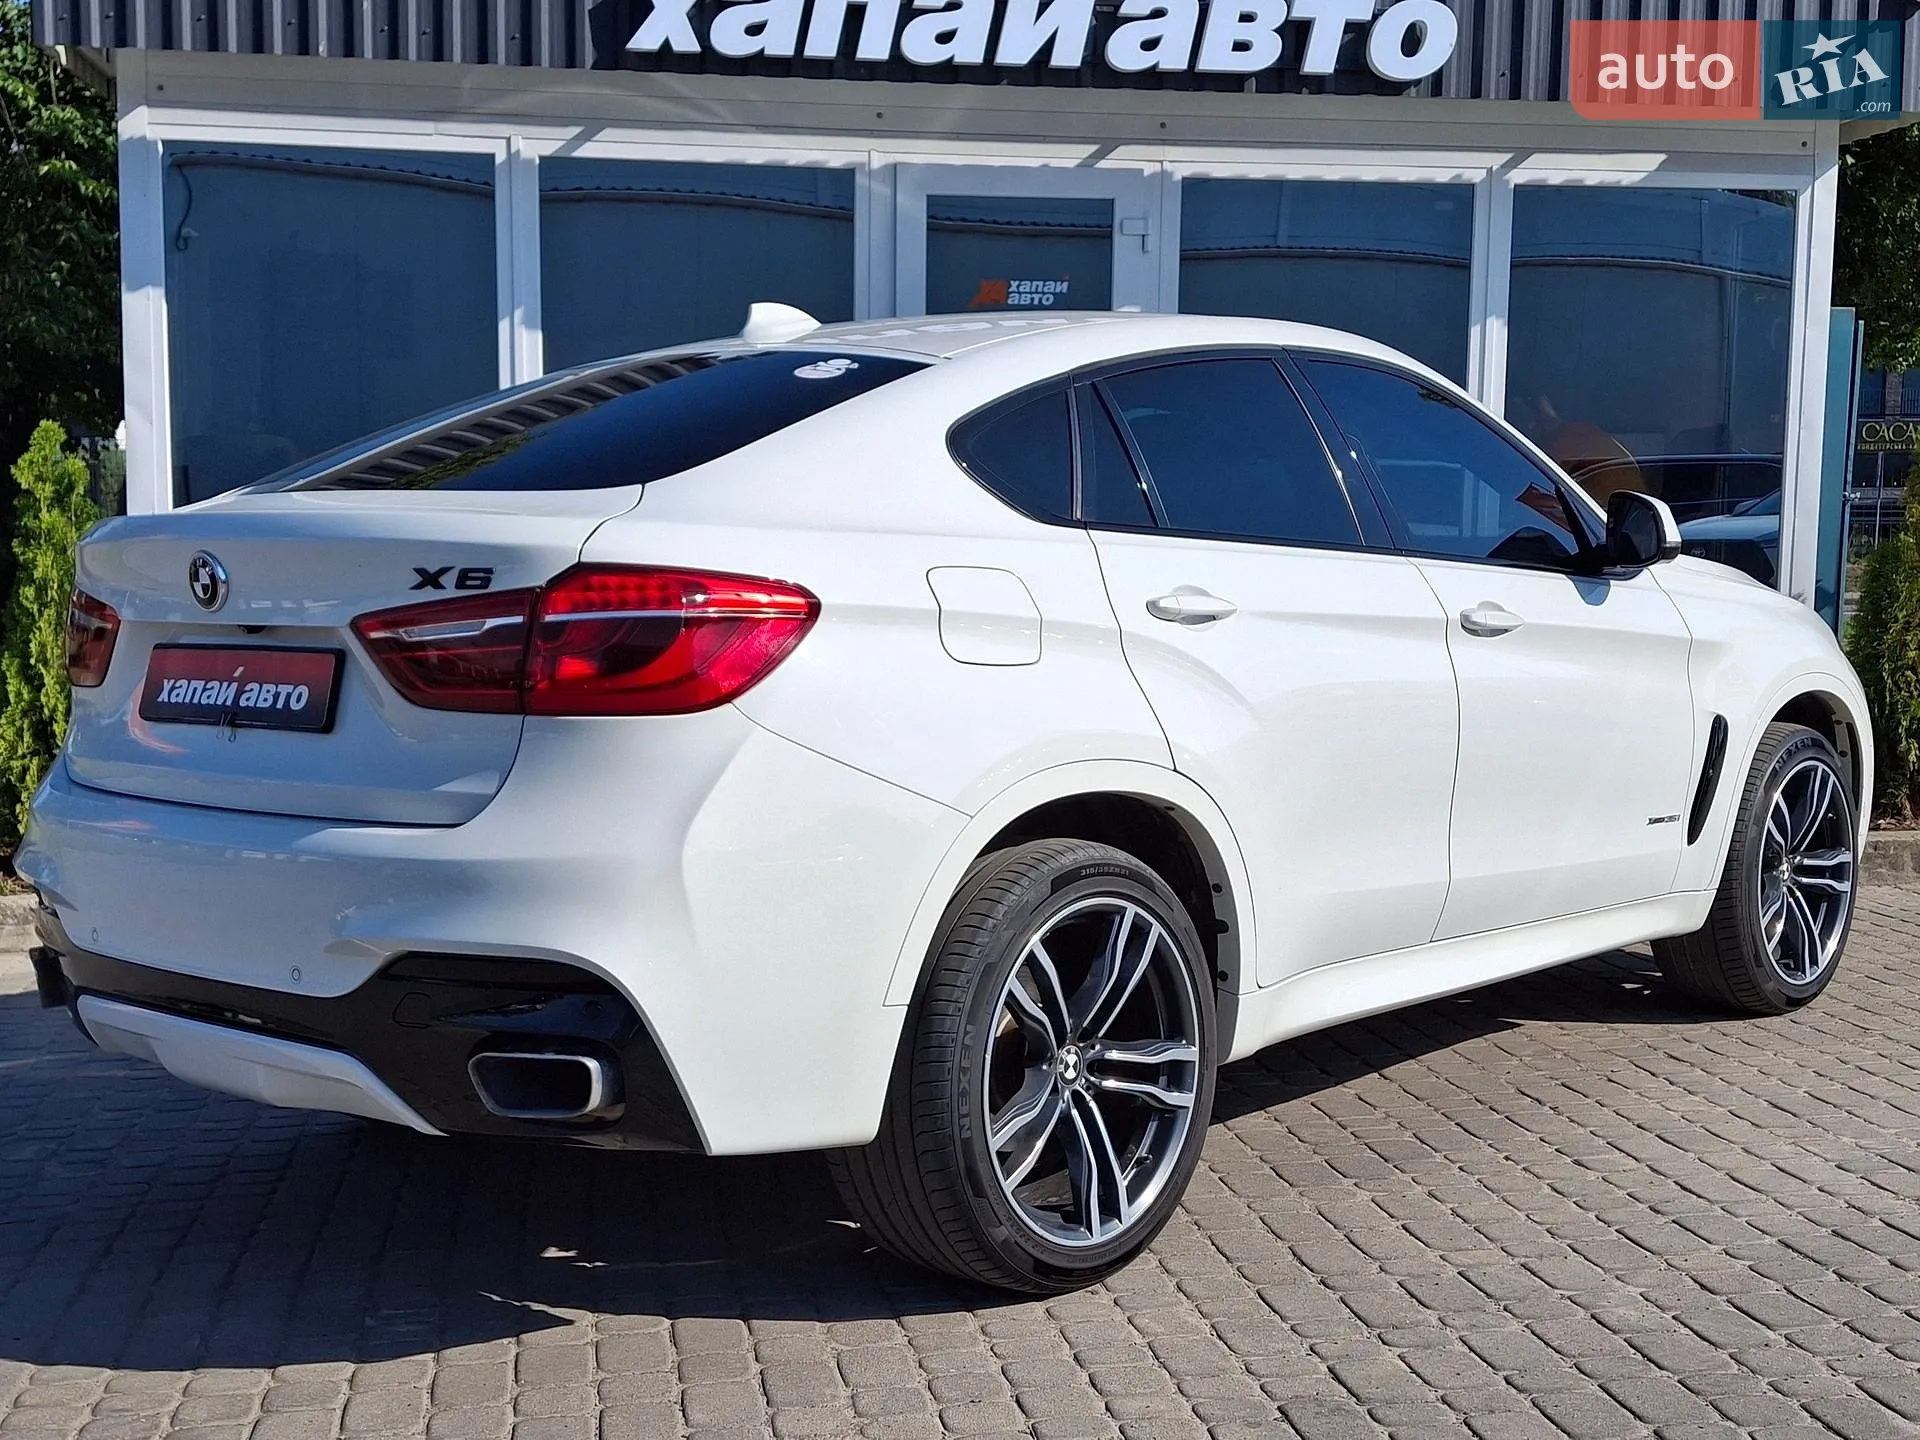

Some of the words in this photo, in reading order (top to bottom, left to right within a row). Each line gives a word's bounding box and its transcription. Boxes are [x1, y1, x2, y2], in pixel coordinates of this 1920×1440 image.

[1105, 0, 1459, 82] авто
[1008, 275, 1071, 293] хапай
[1007, 293, 1054, 305] авто
[1862, 422, 1918, 442] CACA
[408, 566, 496, 590] X6
[157, 665, 245, 706] хапай
[239, 681, 310, 711] авто
[959, 1025, 977, 1139] NEXEN
